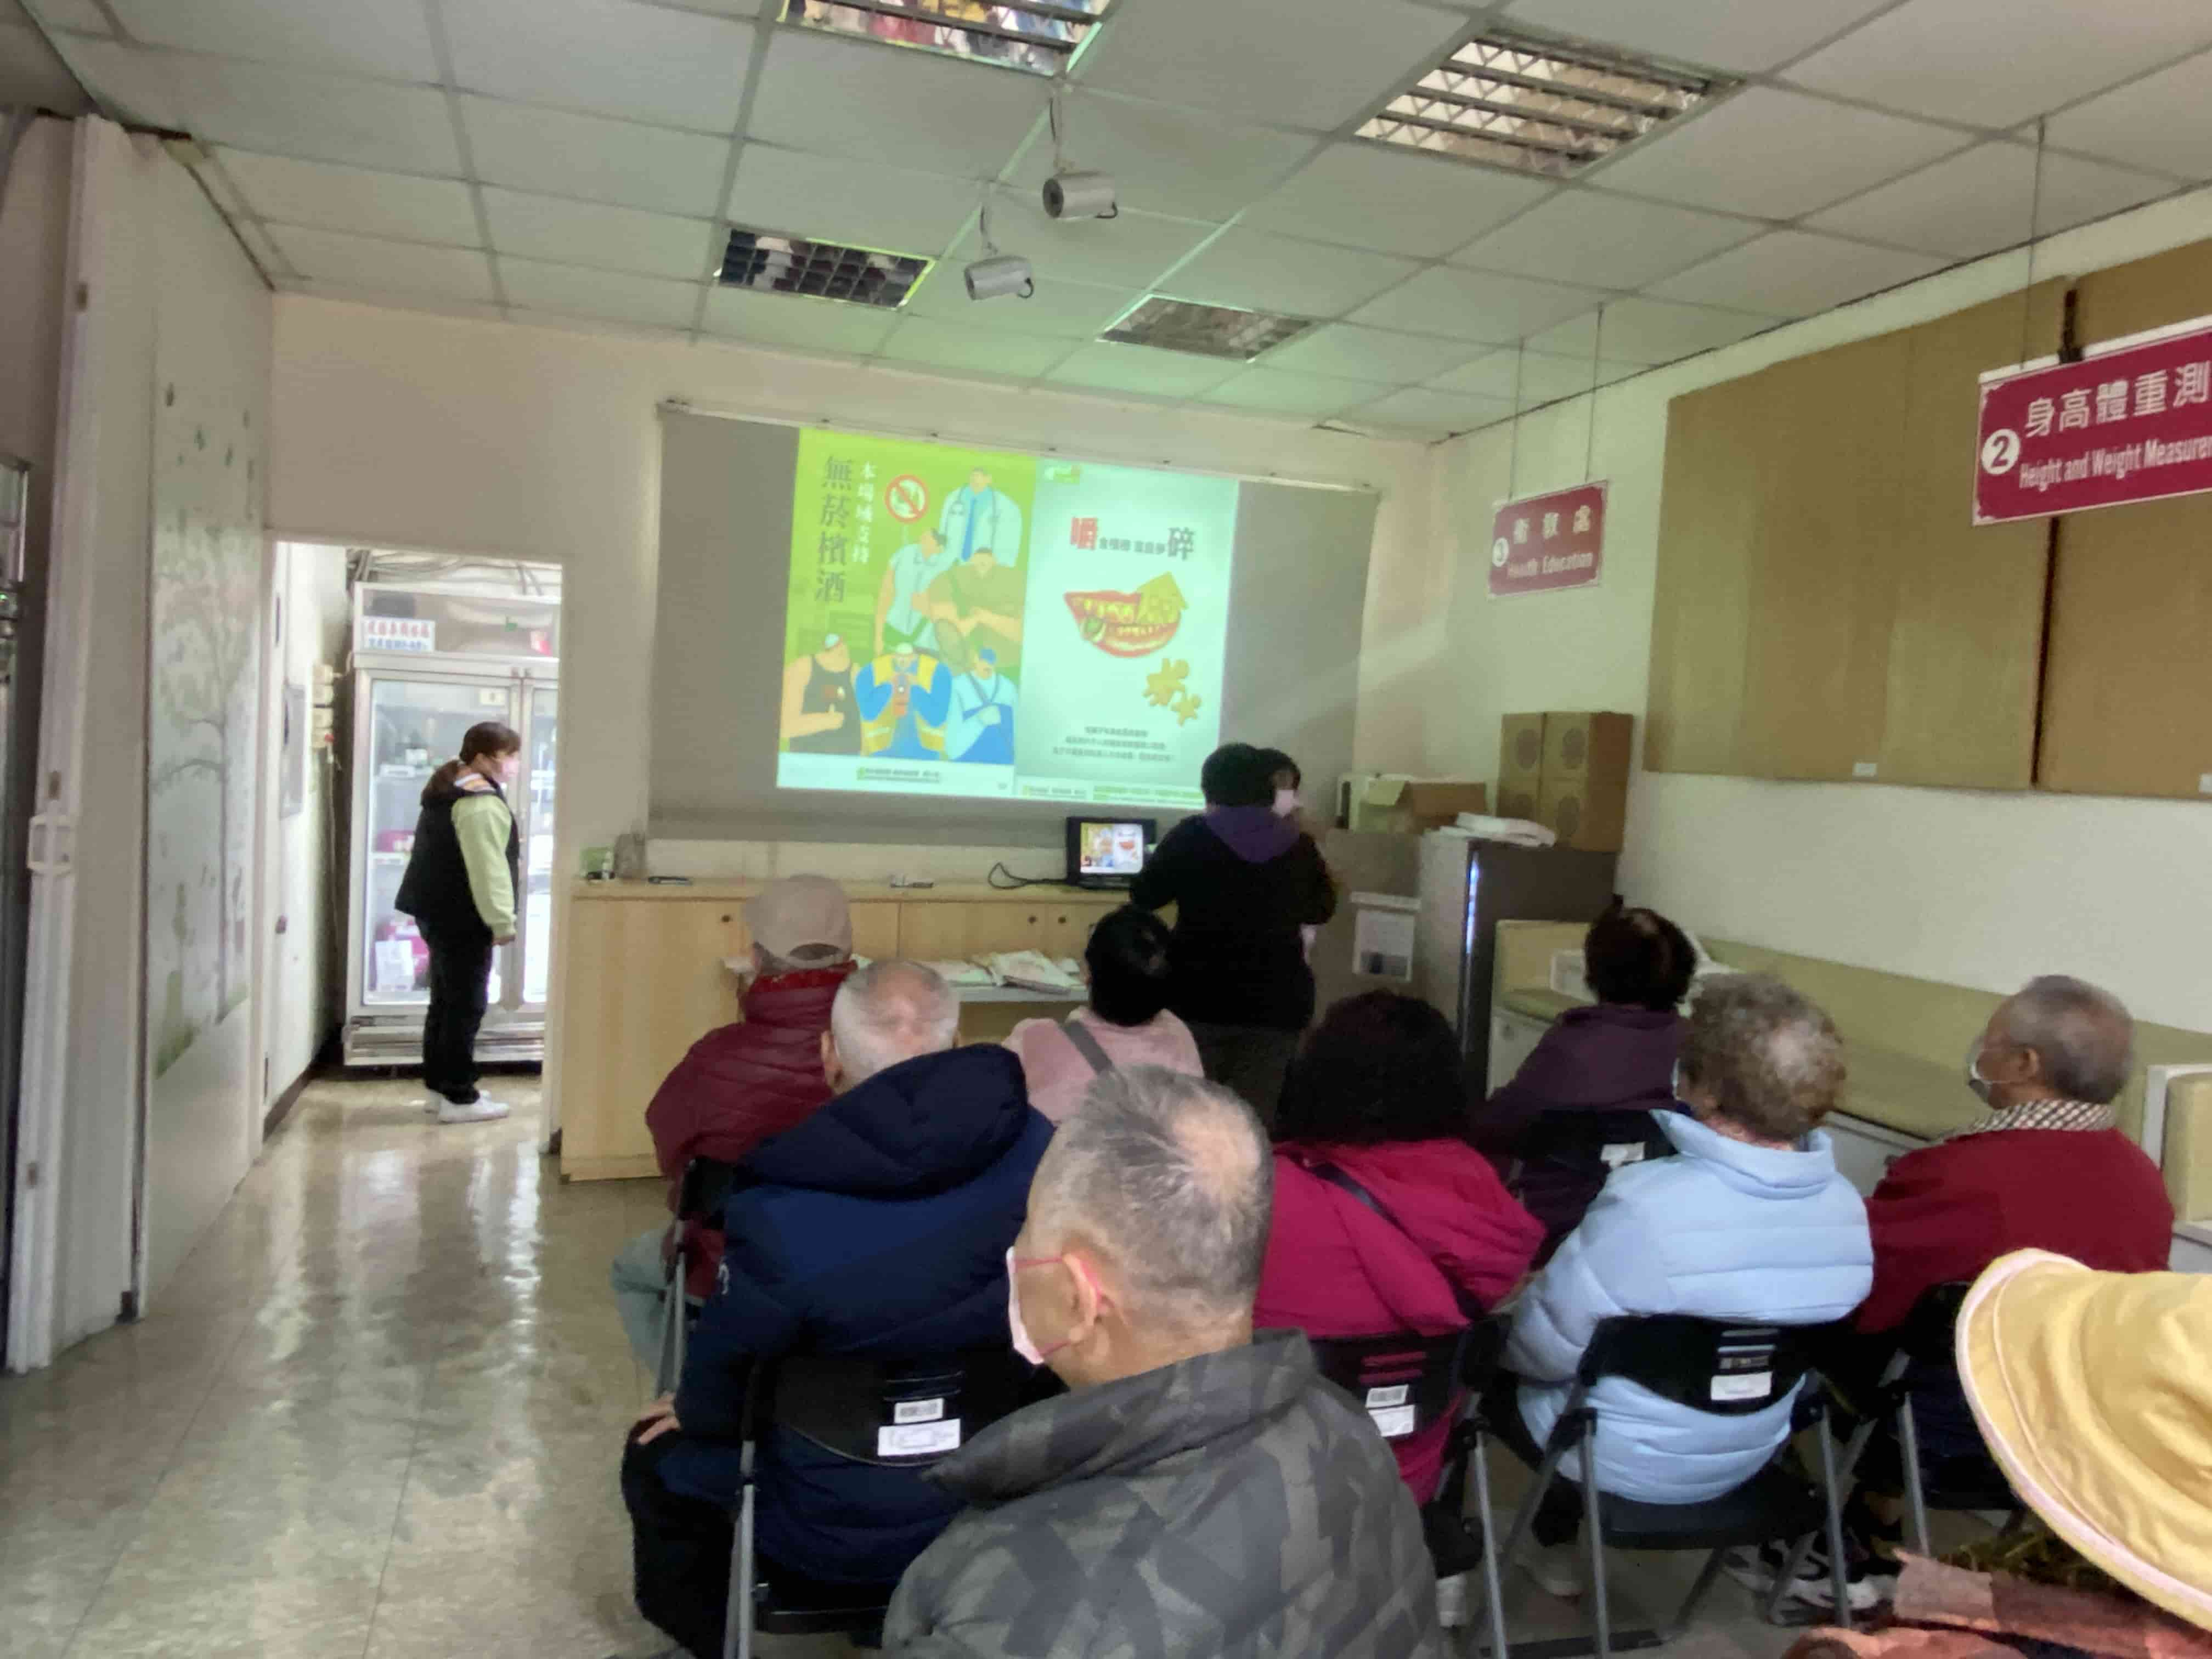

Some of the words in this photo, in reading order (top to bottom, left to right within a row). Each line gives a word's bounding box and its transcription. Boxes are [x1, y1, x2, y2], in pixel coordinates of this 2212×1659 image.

[2025, 360, 2210, 438] 身高體重測
[1991, 435, 2010, 467] 2
[2019, 458, 2063, 492] Height
[2064, 450, 2090, 481] and
[2092, 443, 2142, 480] Weight
